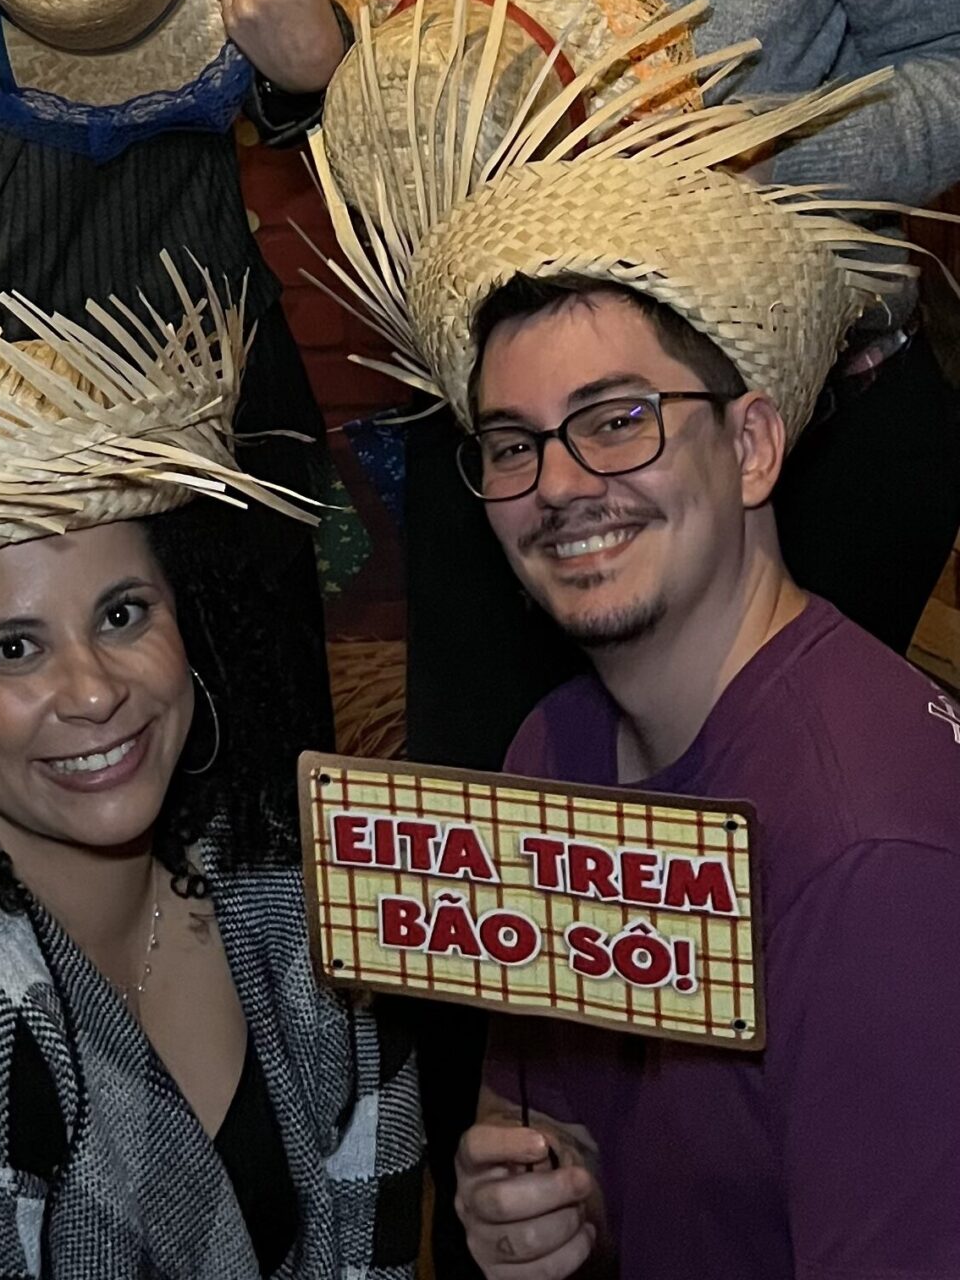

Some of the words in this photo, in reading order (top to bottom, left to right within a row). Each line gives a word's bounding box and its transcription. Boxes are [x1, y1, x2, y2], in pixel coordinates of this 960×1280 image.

[330, 811, 500, 883] EITA
[520, 833, 740, 915] TREM
[378, 887, 541, 966] BÃO
[565, 917, 698, 994] SÔ!
